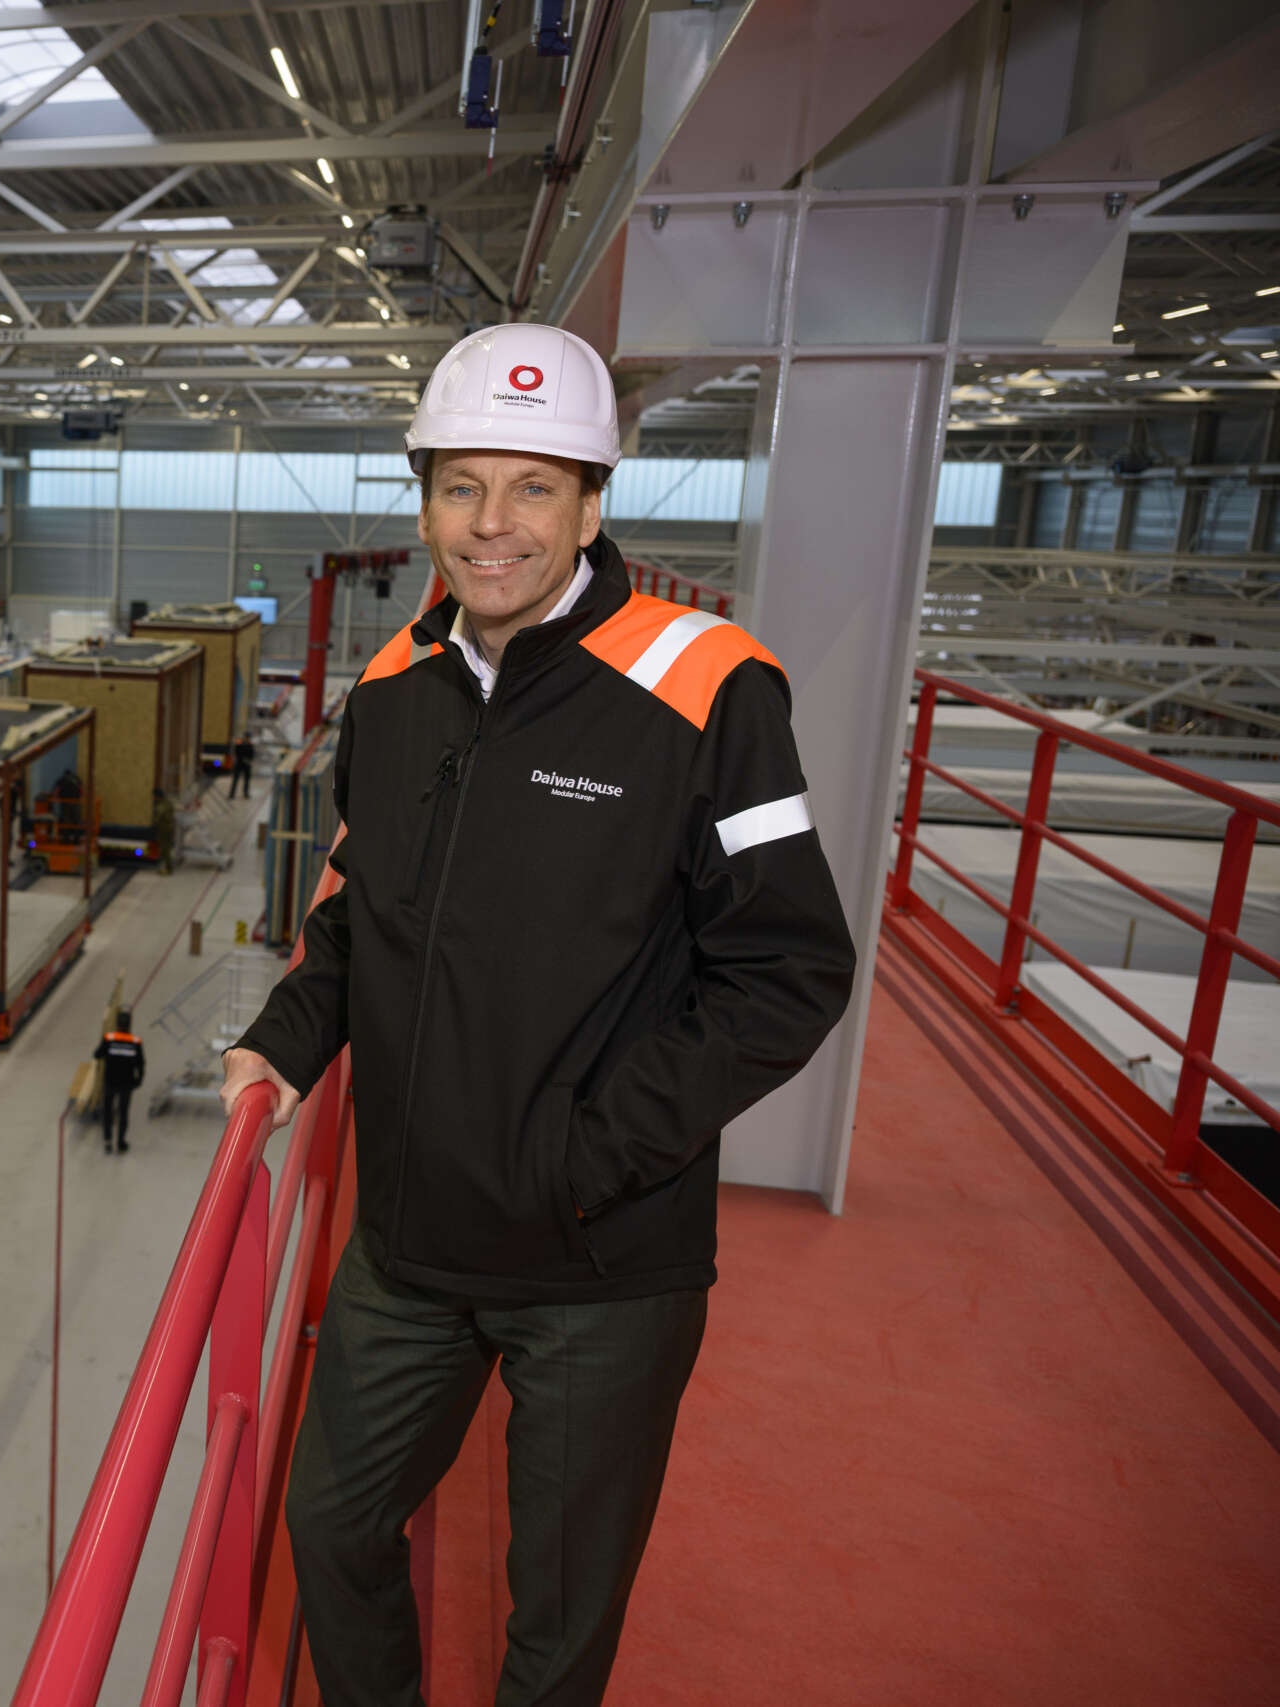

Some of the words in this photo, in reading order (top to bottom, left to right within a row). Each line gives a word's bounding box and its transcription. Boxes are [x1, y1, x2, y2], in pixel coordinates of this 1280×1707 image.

[520, 394, 547, 404] House
[531, 769, 576, 788] Daiwa
[576, 776, 623, 797] House
